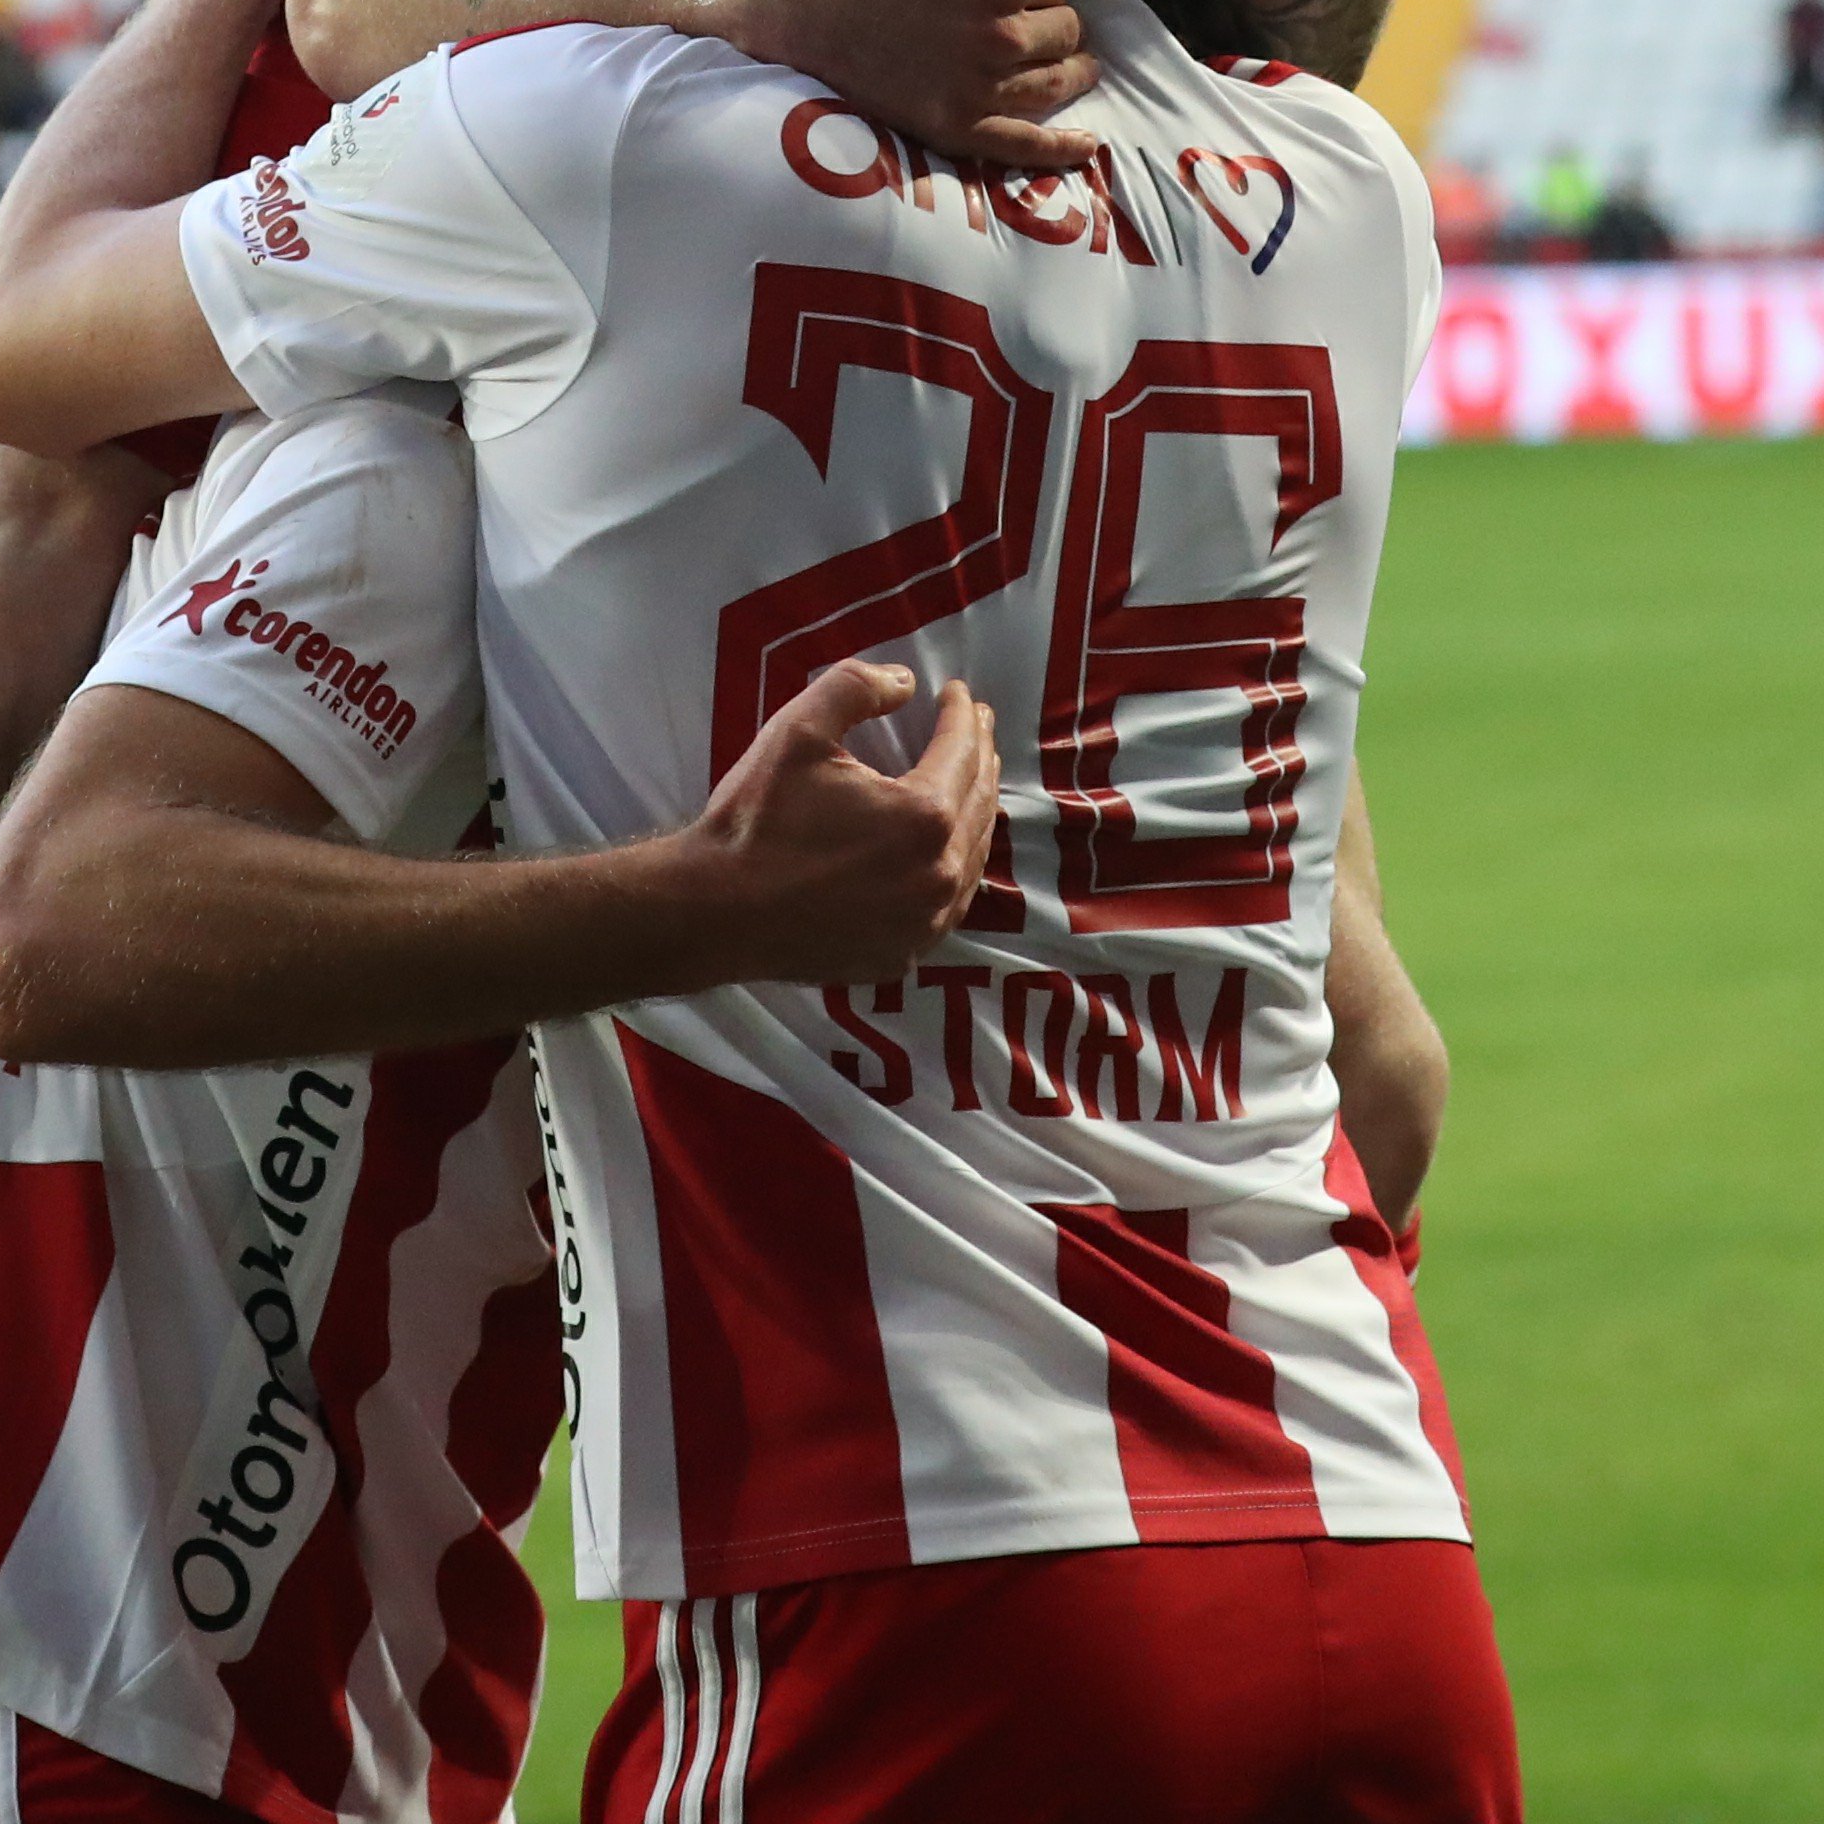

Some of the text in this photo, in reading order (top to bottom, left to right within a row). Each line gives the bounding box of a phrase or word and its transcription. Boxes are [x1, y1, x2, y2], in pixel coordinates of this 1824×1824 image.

[224, 597, 418, 746] corendon
[710, 261, 1343, 934] 26
[303, 680, 396, 761] AIRLINES
[822, 967, 1248, 1124] STORM
